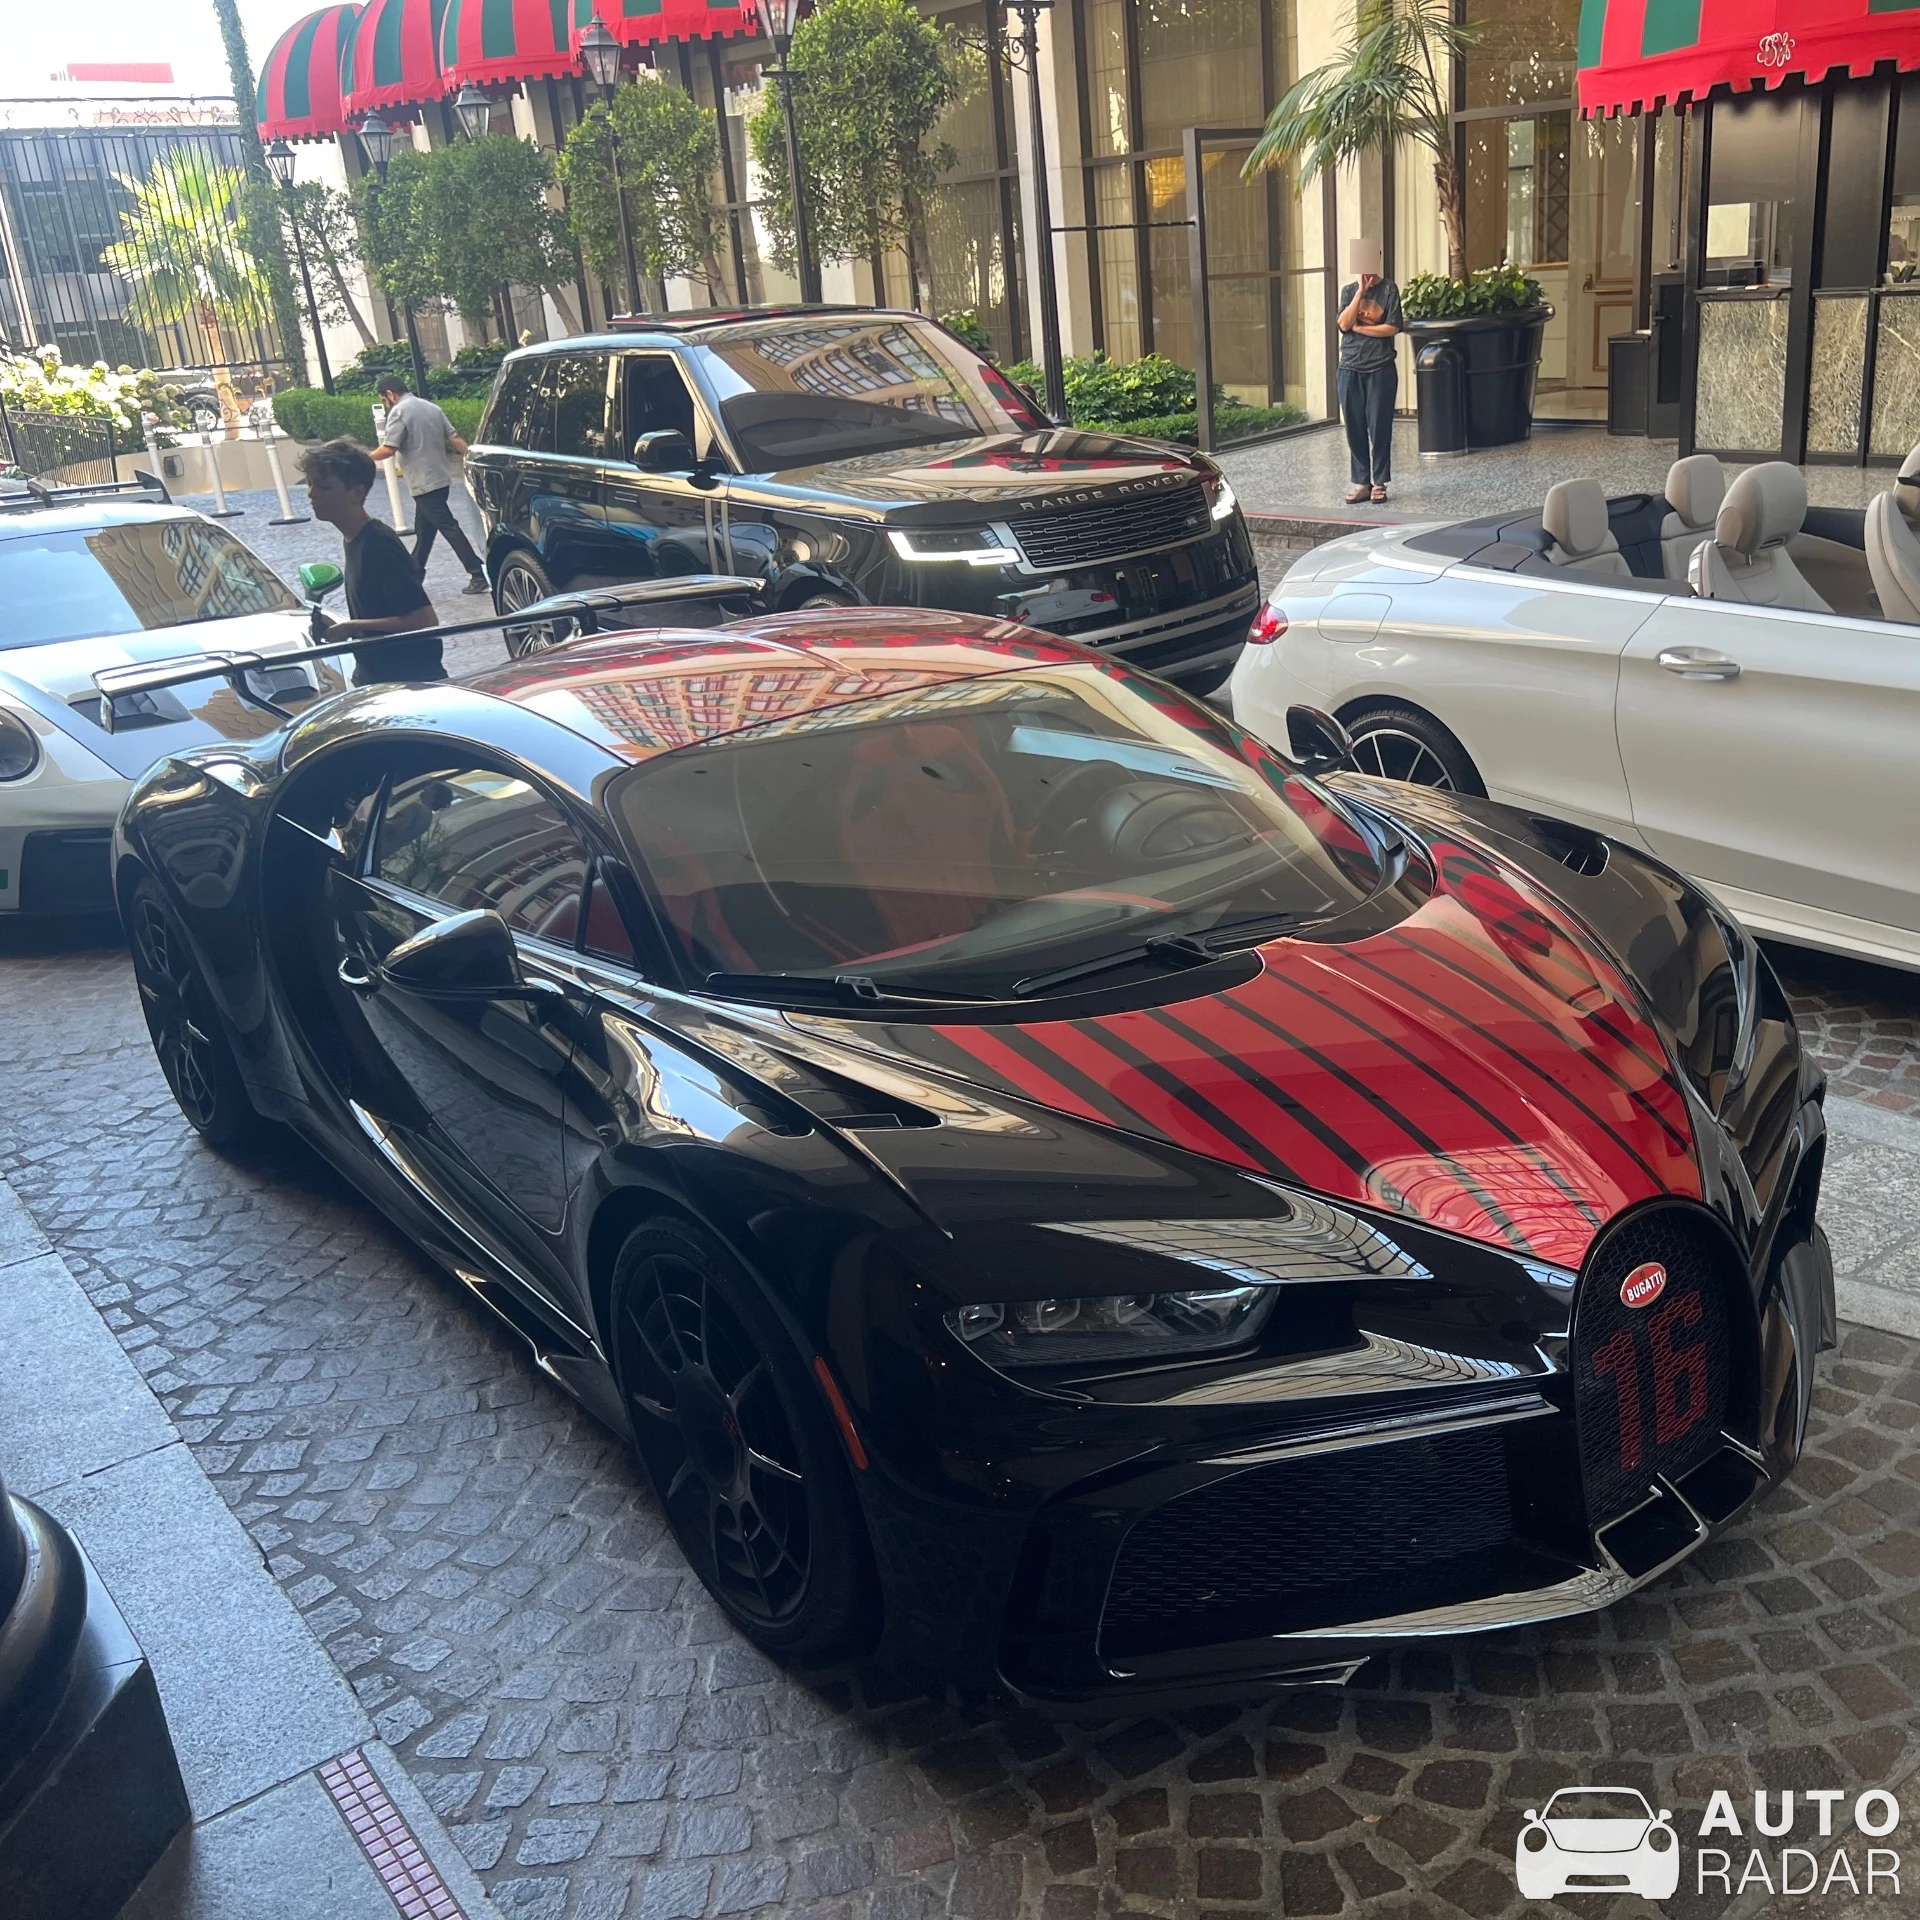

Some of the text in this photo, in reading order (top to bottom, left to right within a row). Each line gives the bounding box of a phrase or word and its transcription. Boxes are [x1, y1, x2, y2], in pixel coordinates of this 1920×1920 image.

[1019, 473, 1186, 512] RANGE ROVER
[1626, 1270, 1664, 1302] BUGATTI
[1592, 1291, 1707, 1473] 16
